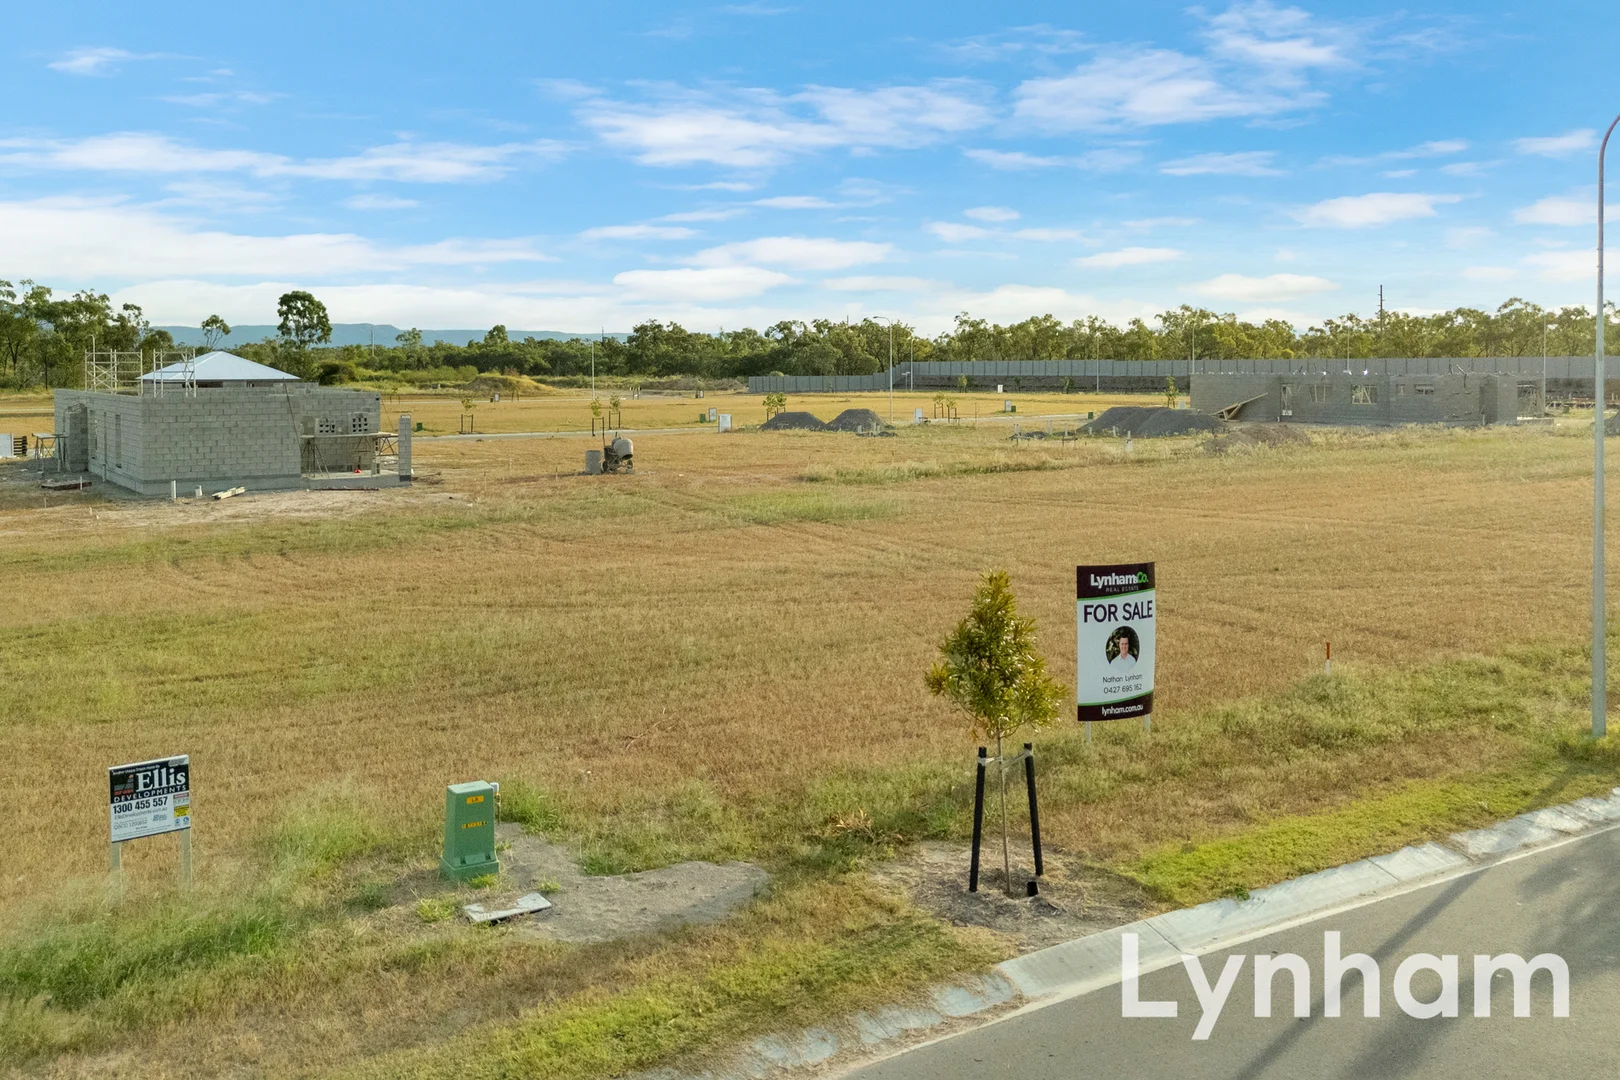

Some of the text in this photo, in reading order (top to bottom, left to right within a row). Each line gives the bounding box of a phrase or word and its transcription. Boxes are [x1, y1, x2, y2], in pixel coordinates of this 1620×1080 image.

[1084, 600, 1153, 623] FOR SALE
[1102, 675, 1123, 684] Nathan
[1103, 686, 1121, 694] 0427
[1121, 685, 1133, 693] 695
[1101, 704, 1144, 717] lynham.com.au
[135, 767, 186, 792] Ellis
[113, 784, 187, 803] DEVELOPMENTS
[112, 802, 133, 815] 1300
[134, 799, 151, 811] 455
[152, 796, 168, 808] 557
